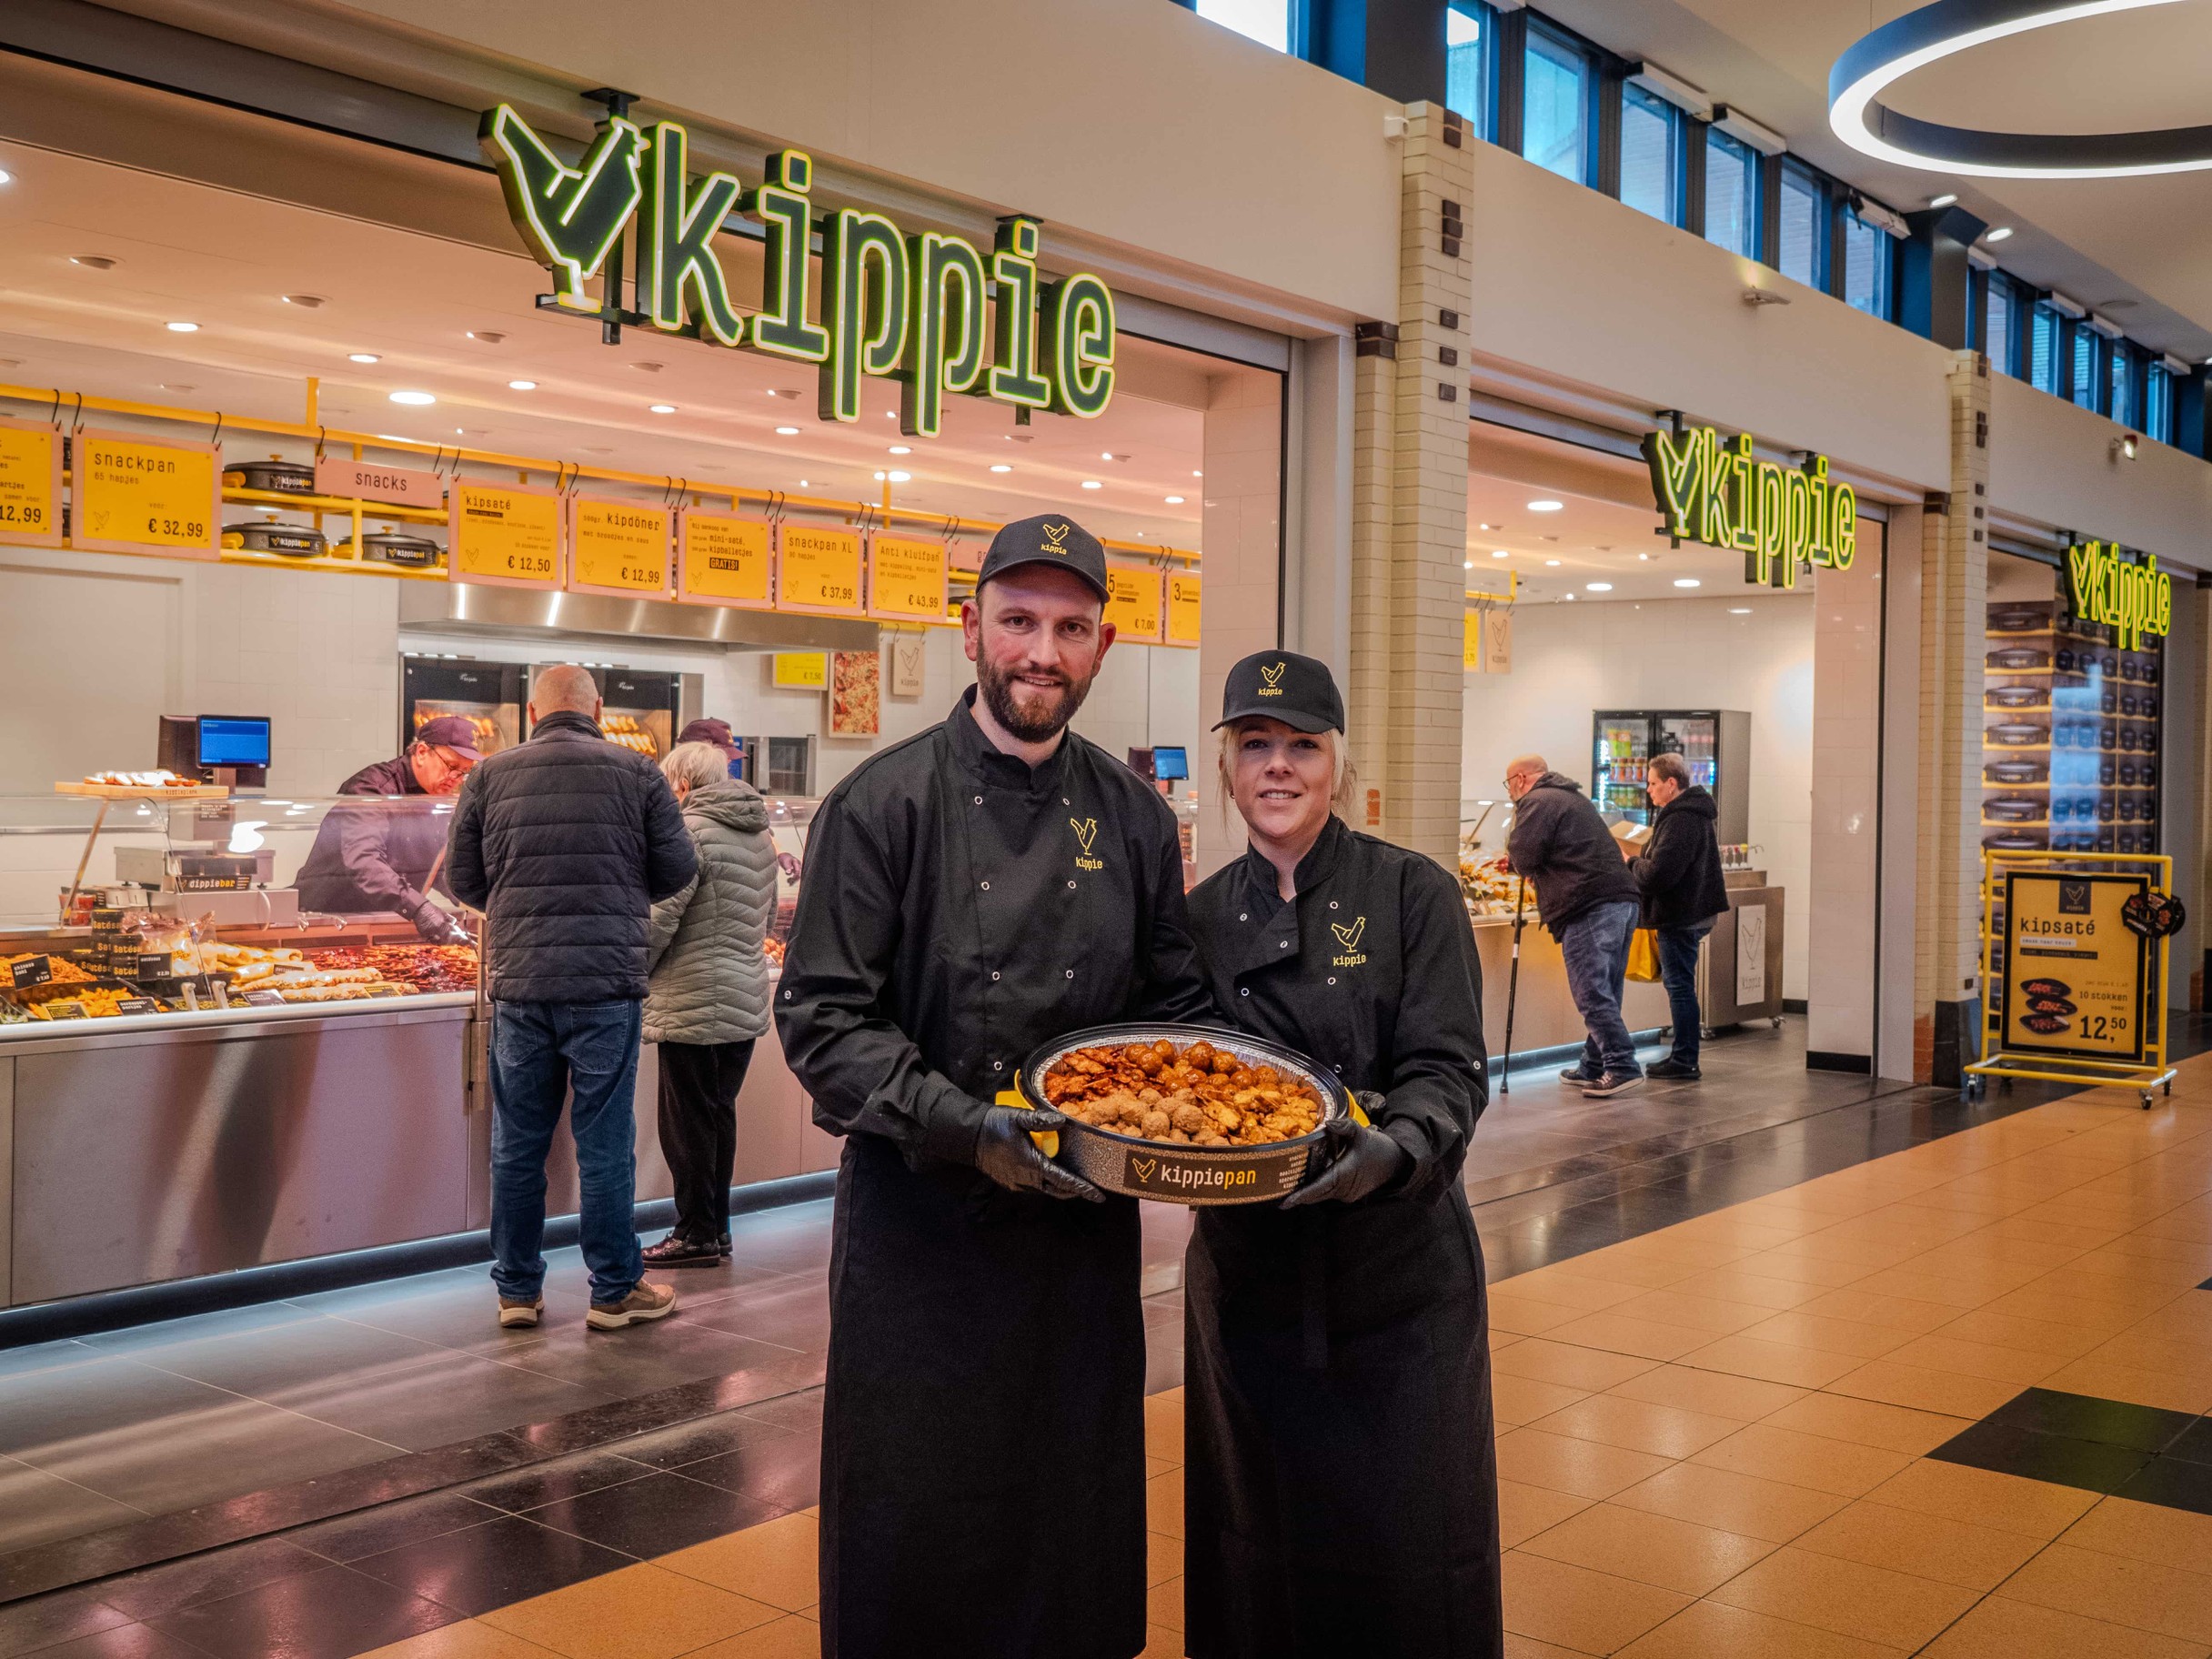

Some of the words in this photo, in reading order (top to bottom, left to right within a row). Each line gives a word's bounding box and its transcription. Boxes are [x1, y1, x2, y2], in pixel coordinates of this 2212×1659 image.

[651, 120, 1116, 438] kippie
[94, 452, 176, 474] snackpan
[94, 471, 105, 481] 65
[109, 473, 140, 485] hapjes
[355, 471, 407, 492] snacks
[466, 496, 511, 510] kipsaté
[1701, 427, 1856, 589] kippie
[148, 518, 157, 533] €
[163, 519, 204, 538] 32,99
[607, 513, 660, 531] kipdöner
[789, 537, 837, 552] snackpan
[841, 540, 853, 554] XL
[1040, 543, 1068, 556] kippie
[508, 556, 515, 568] €
[520, 557, 551, 573] 12,50
[710, 558, 739, 570] GRATIS!
[621, 567, 628, 580] €
[632, 569, 660, 584] 12,99
[1108, 573, 1115, 593] 5
[821, 585, 827, 598] €
[830, 587, 853, 600] 37,99
[1174, 582, 1181, 601] 3
[2090, 540, 2171, 651] kippie
[909, 594, 914, 605] €
[916, 596, 939, 608] 43,99
[1134, 618, 1139, 628] €
[1141, 619, 1155, 630] 7,00
[1258, 687, 1283, 697] kippie
[1075, 855, 1103, 872] kippie
[189, 879, 236, 890] dippiebar
[2020, 917, 2096, 936] kipsaté
[1332, 952, 1367, 968] kippie
[2079, 990, 2089, 1000] 10
[2091, 992, 2128, 1002] stokken
[1161, 1163, 1257, 1190] kippiepan
